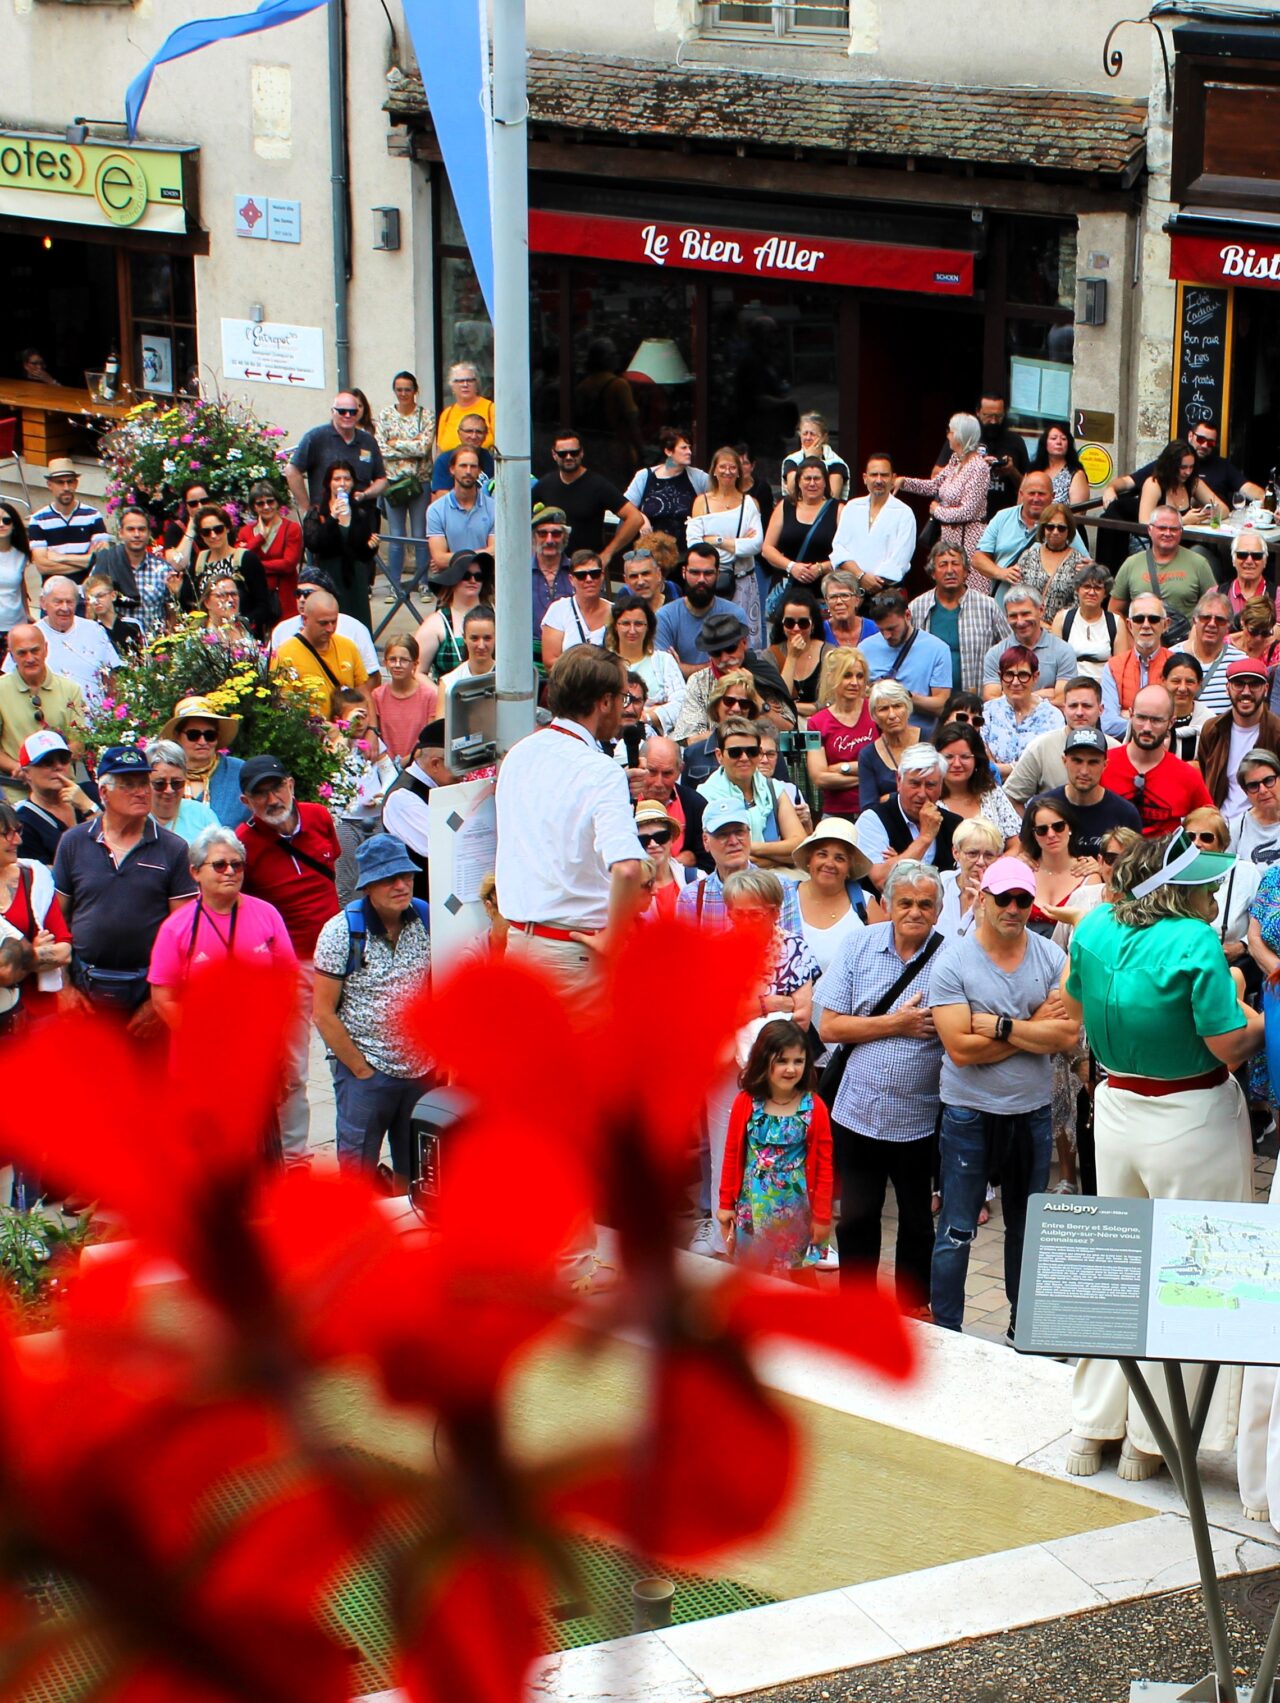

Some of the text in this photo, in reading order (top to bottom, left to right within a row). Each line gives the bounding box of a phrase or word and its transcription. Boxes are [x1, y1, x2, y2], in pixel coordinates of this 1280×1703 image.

[641, 225, 824, 272] Le Bien Aller
[1183, 330, 1200, 345] Bon
[1184, 349, 1191, 362] 2
[1181, 372, 1188, 384] à
[1192, 390, 1205, 402] de
[1043, 1202, 1098, 1216] Aubigny
[1040, 1229, 1119, 1238] Aubigny-sur-Nère
[1066, 1223, 1090, 1231] Berry
[1102, 1225, 1141, 1233] Sologne,
